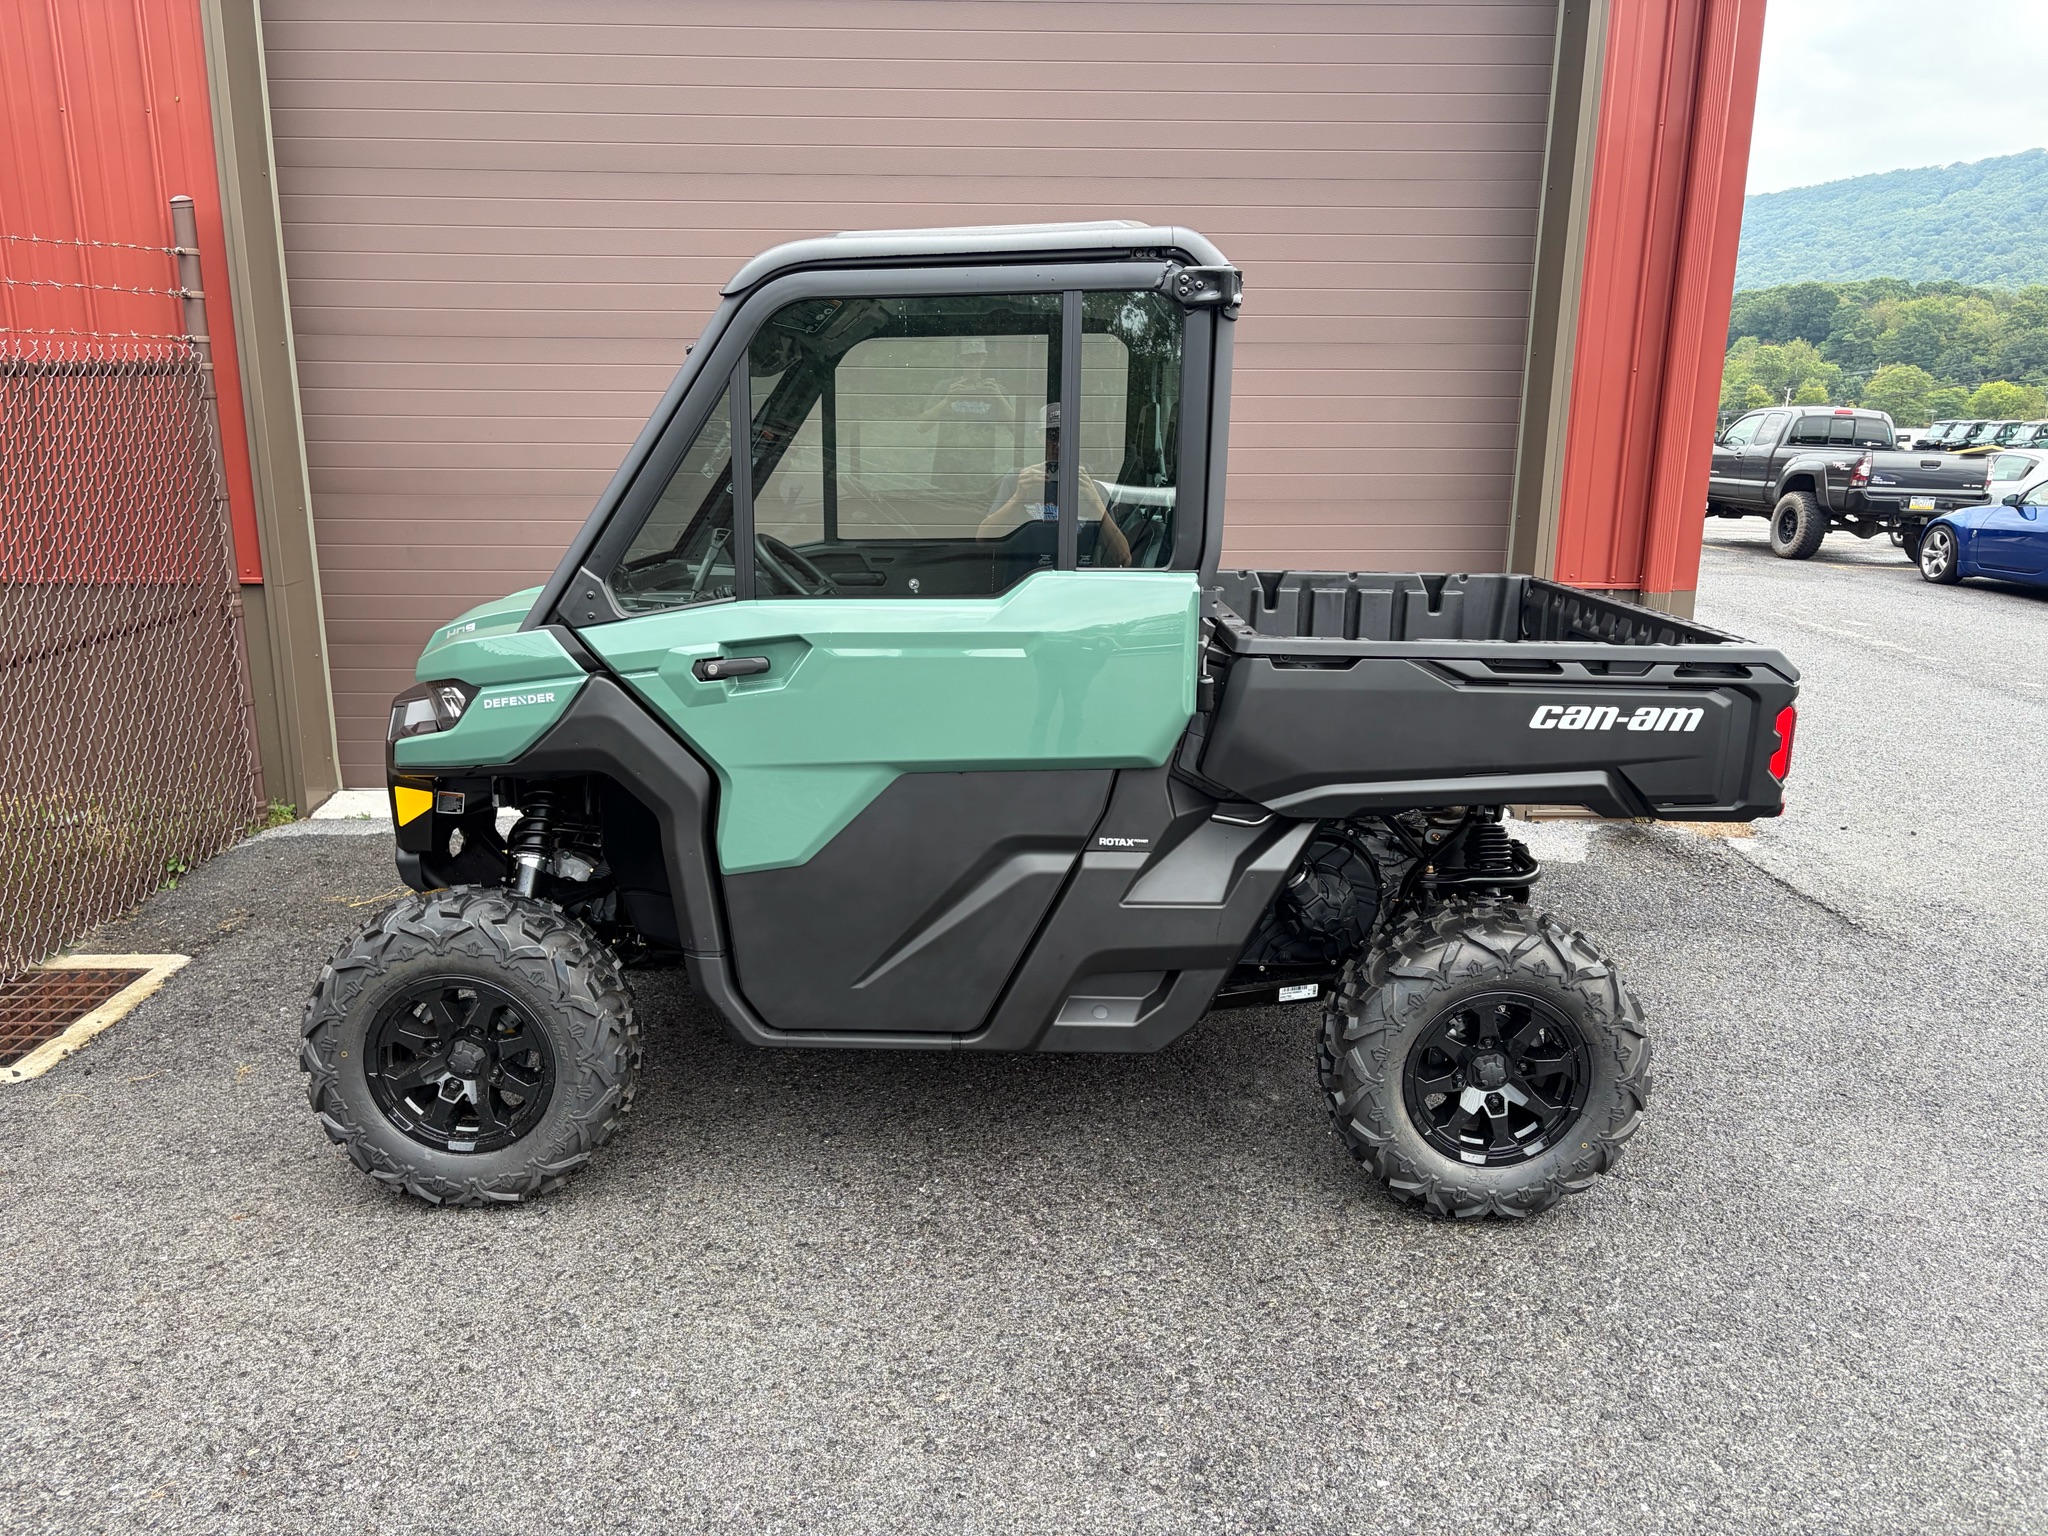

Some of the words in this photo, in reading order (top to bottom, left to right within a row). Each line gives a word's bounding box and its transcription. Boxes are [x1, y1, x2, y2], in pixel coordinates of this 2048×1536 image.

[483, 692, 555, 709] DEFENDER
[1528, 705, 1705, 732] can-am
[1099, 837, 1134, 847] ROTAX
[545, 1015, 571, 1069] FORCE
